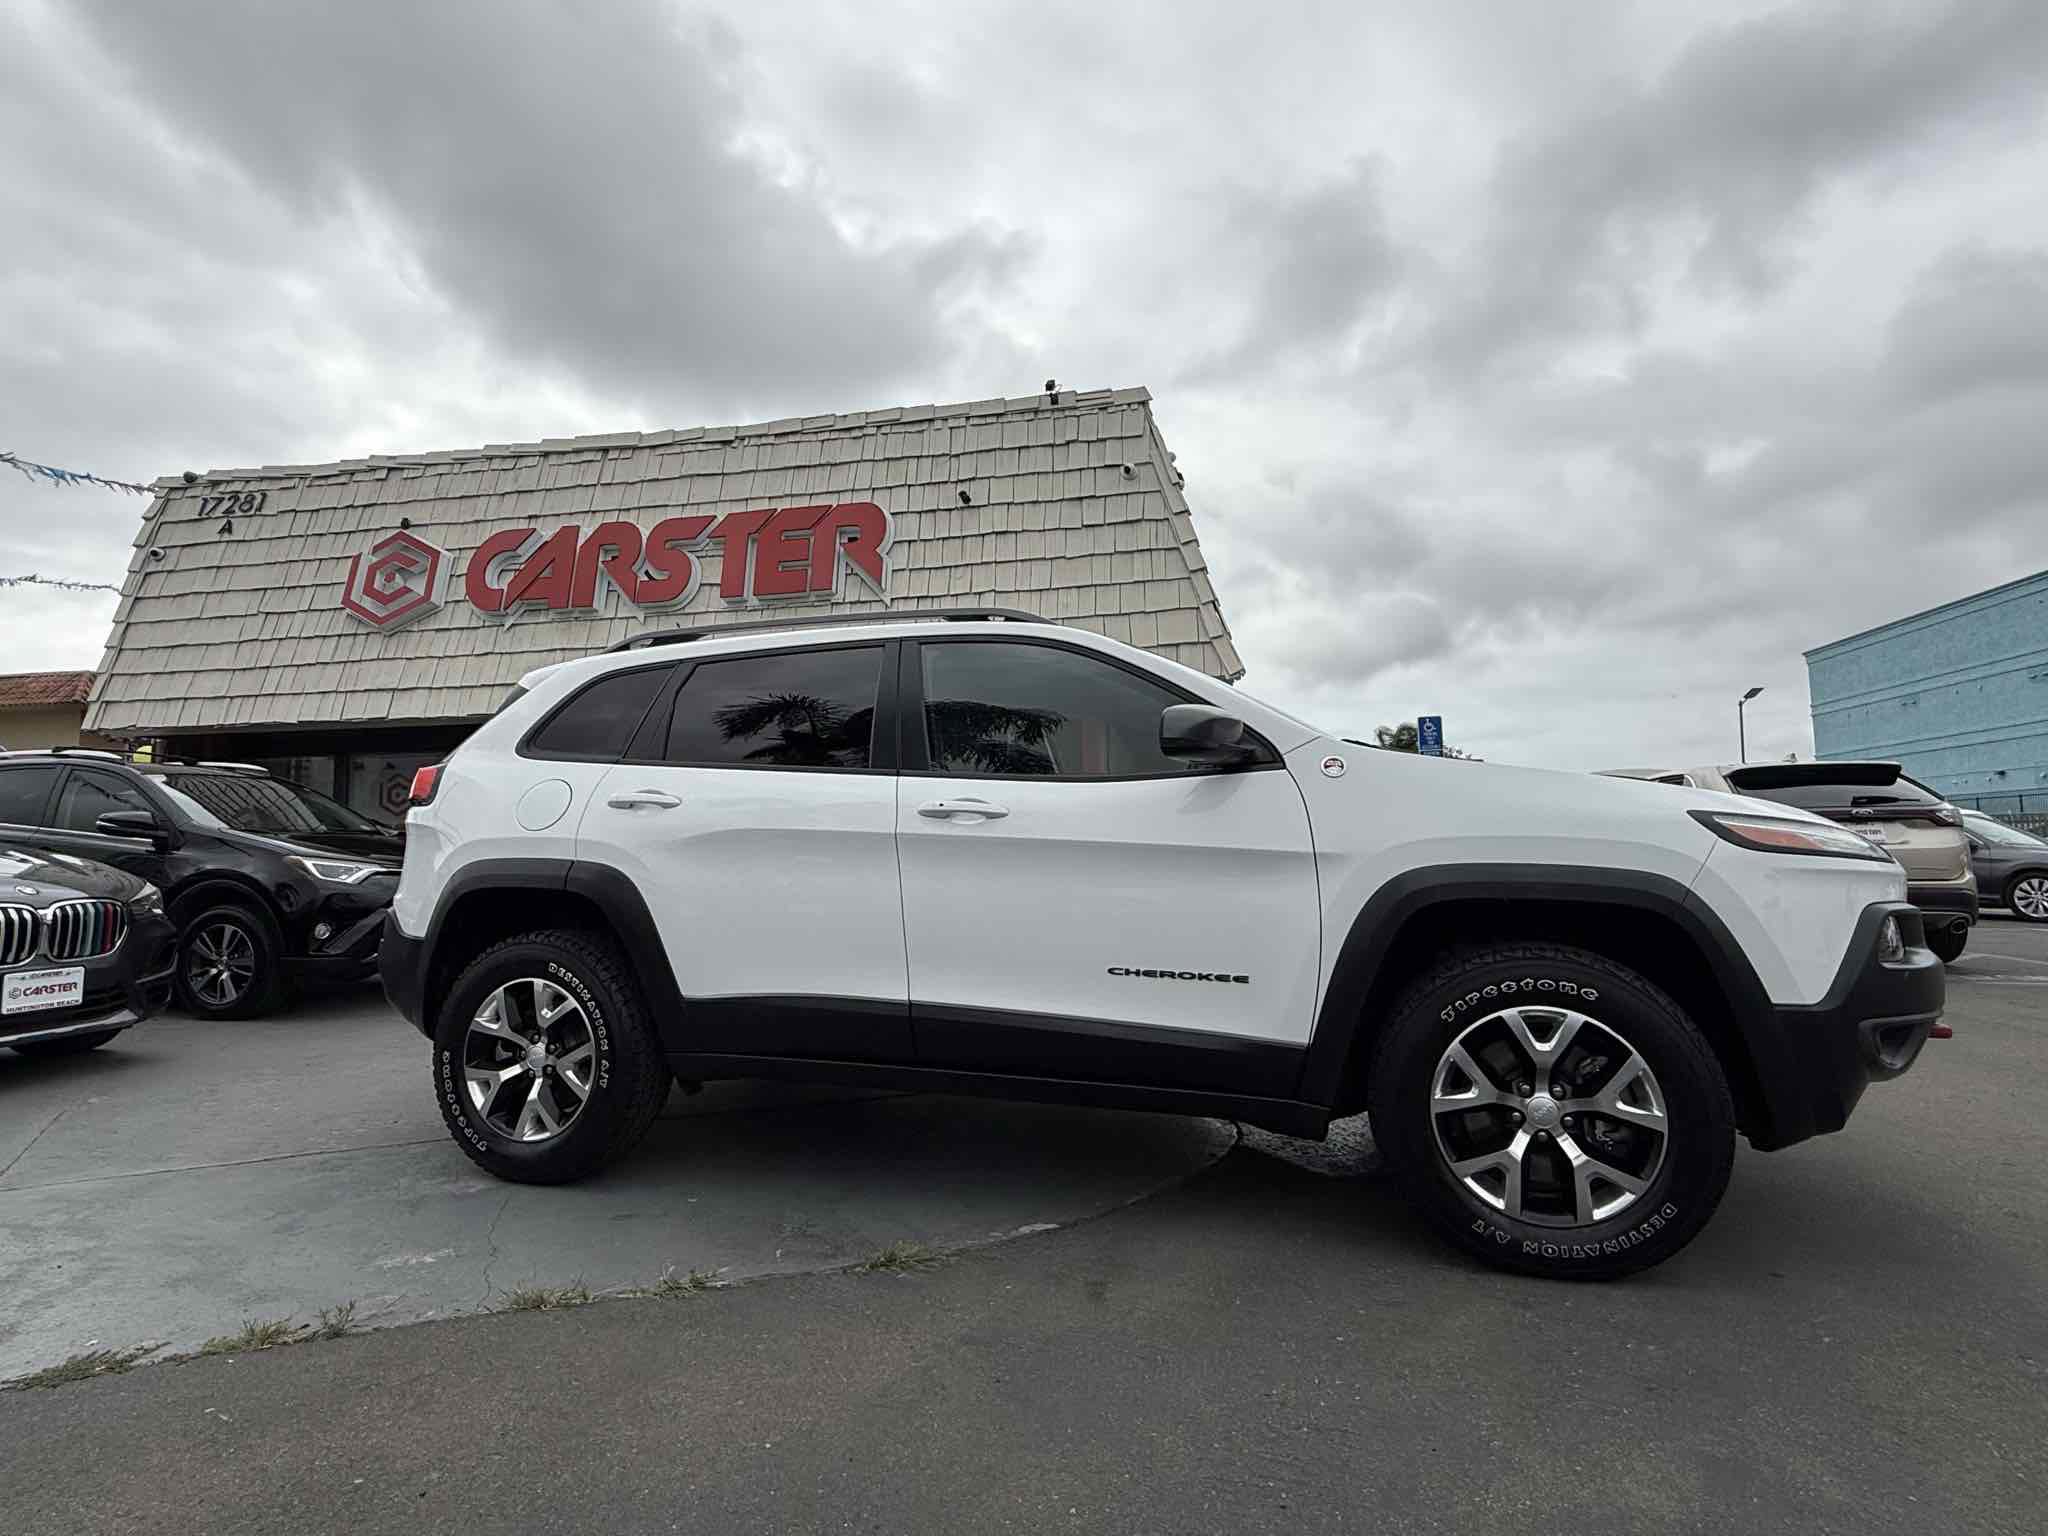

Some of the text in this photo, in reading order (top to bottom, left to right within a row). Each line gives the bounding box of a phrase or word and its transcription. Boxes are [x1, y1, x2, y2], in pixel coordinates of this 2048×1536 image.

[198, 492, 268, 516] 17281
[217, 518, 233, 535] A
[464, 501, 890, 617] CARSTER
[23, 982, 78, 997] CARSTER
[1107, 967, 1250, 984] CHEROKEE
[548, 962, 609, 1051] DESTINATION
[1440, 977, 1599, 1023] Firestone
[1471, 1202, 1678, 1258] DESTINATION A/T
